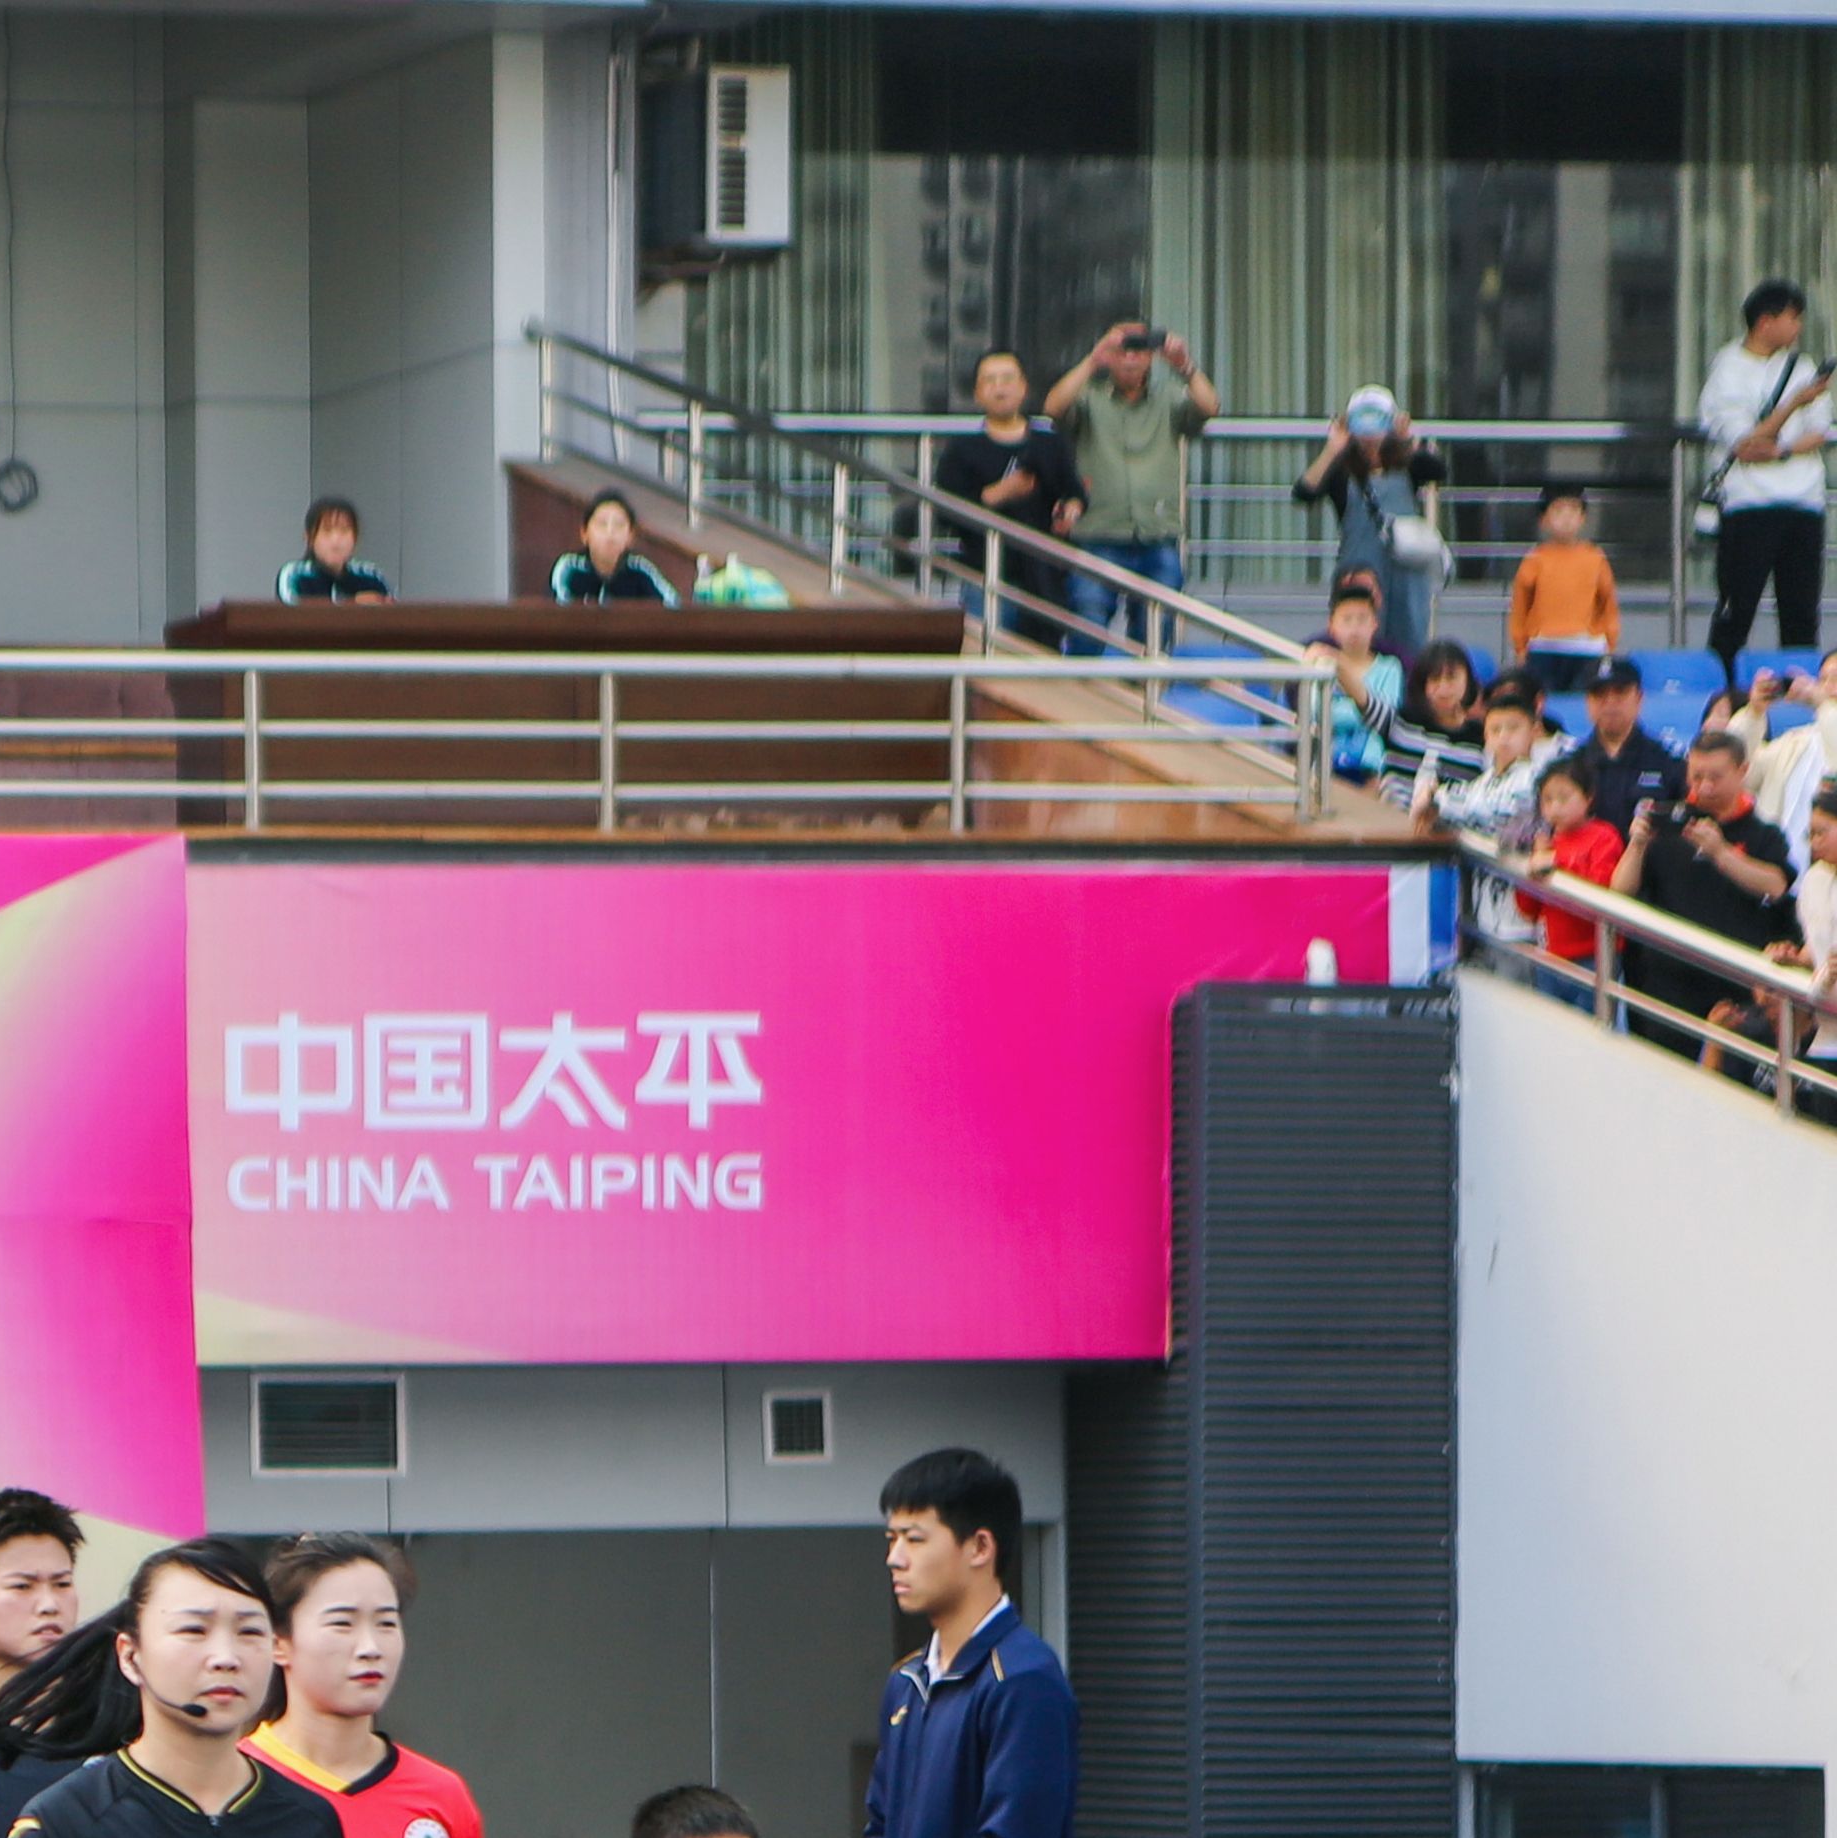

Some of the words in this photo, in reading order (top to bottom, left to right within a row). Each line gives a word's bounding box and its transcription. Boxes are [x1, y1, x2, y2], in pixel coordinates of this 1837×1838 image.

[224, 1011, 763, 1131] 中国太平
[226, 1153, 450, 1211] CHINA
[473, 1152, 763, 1212] TAIPING
